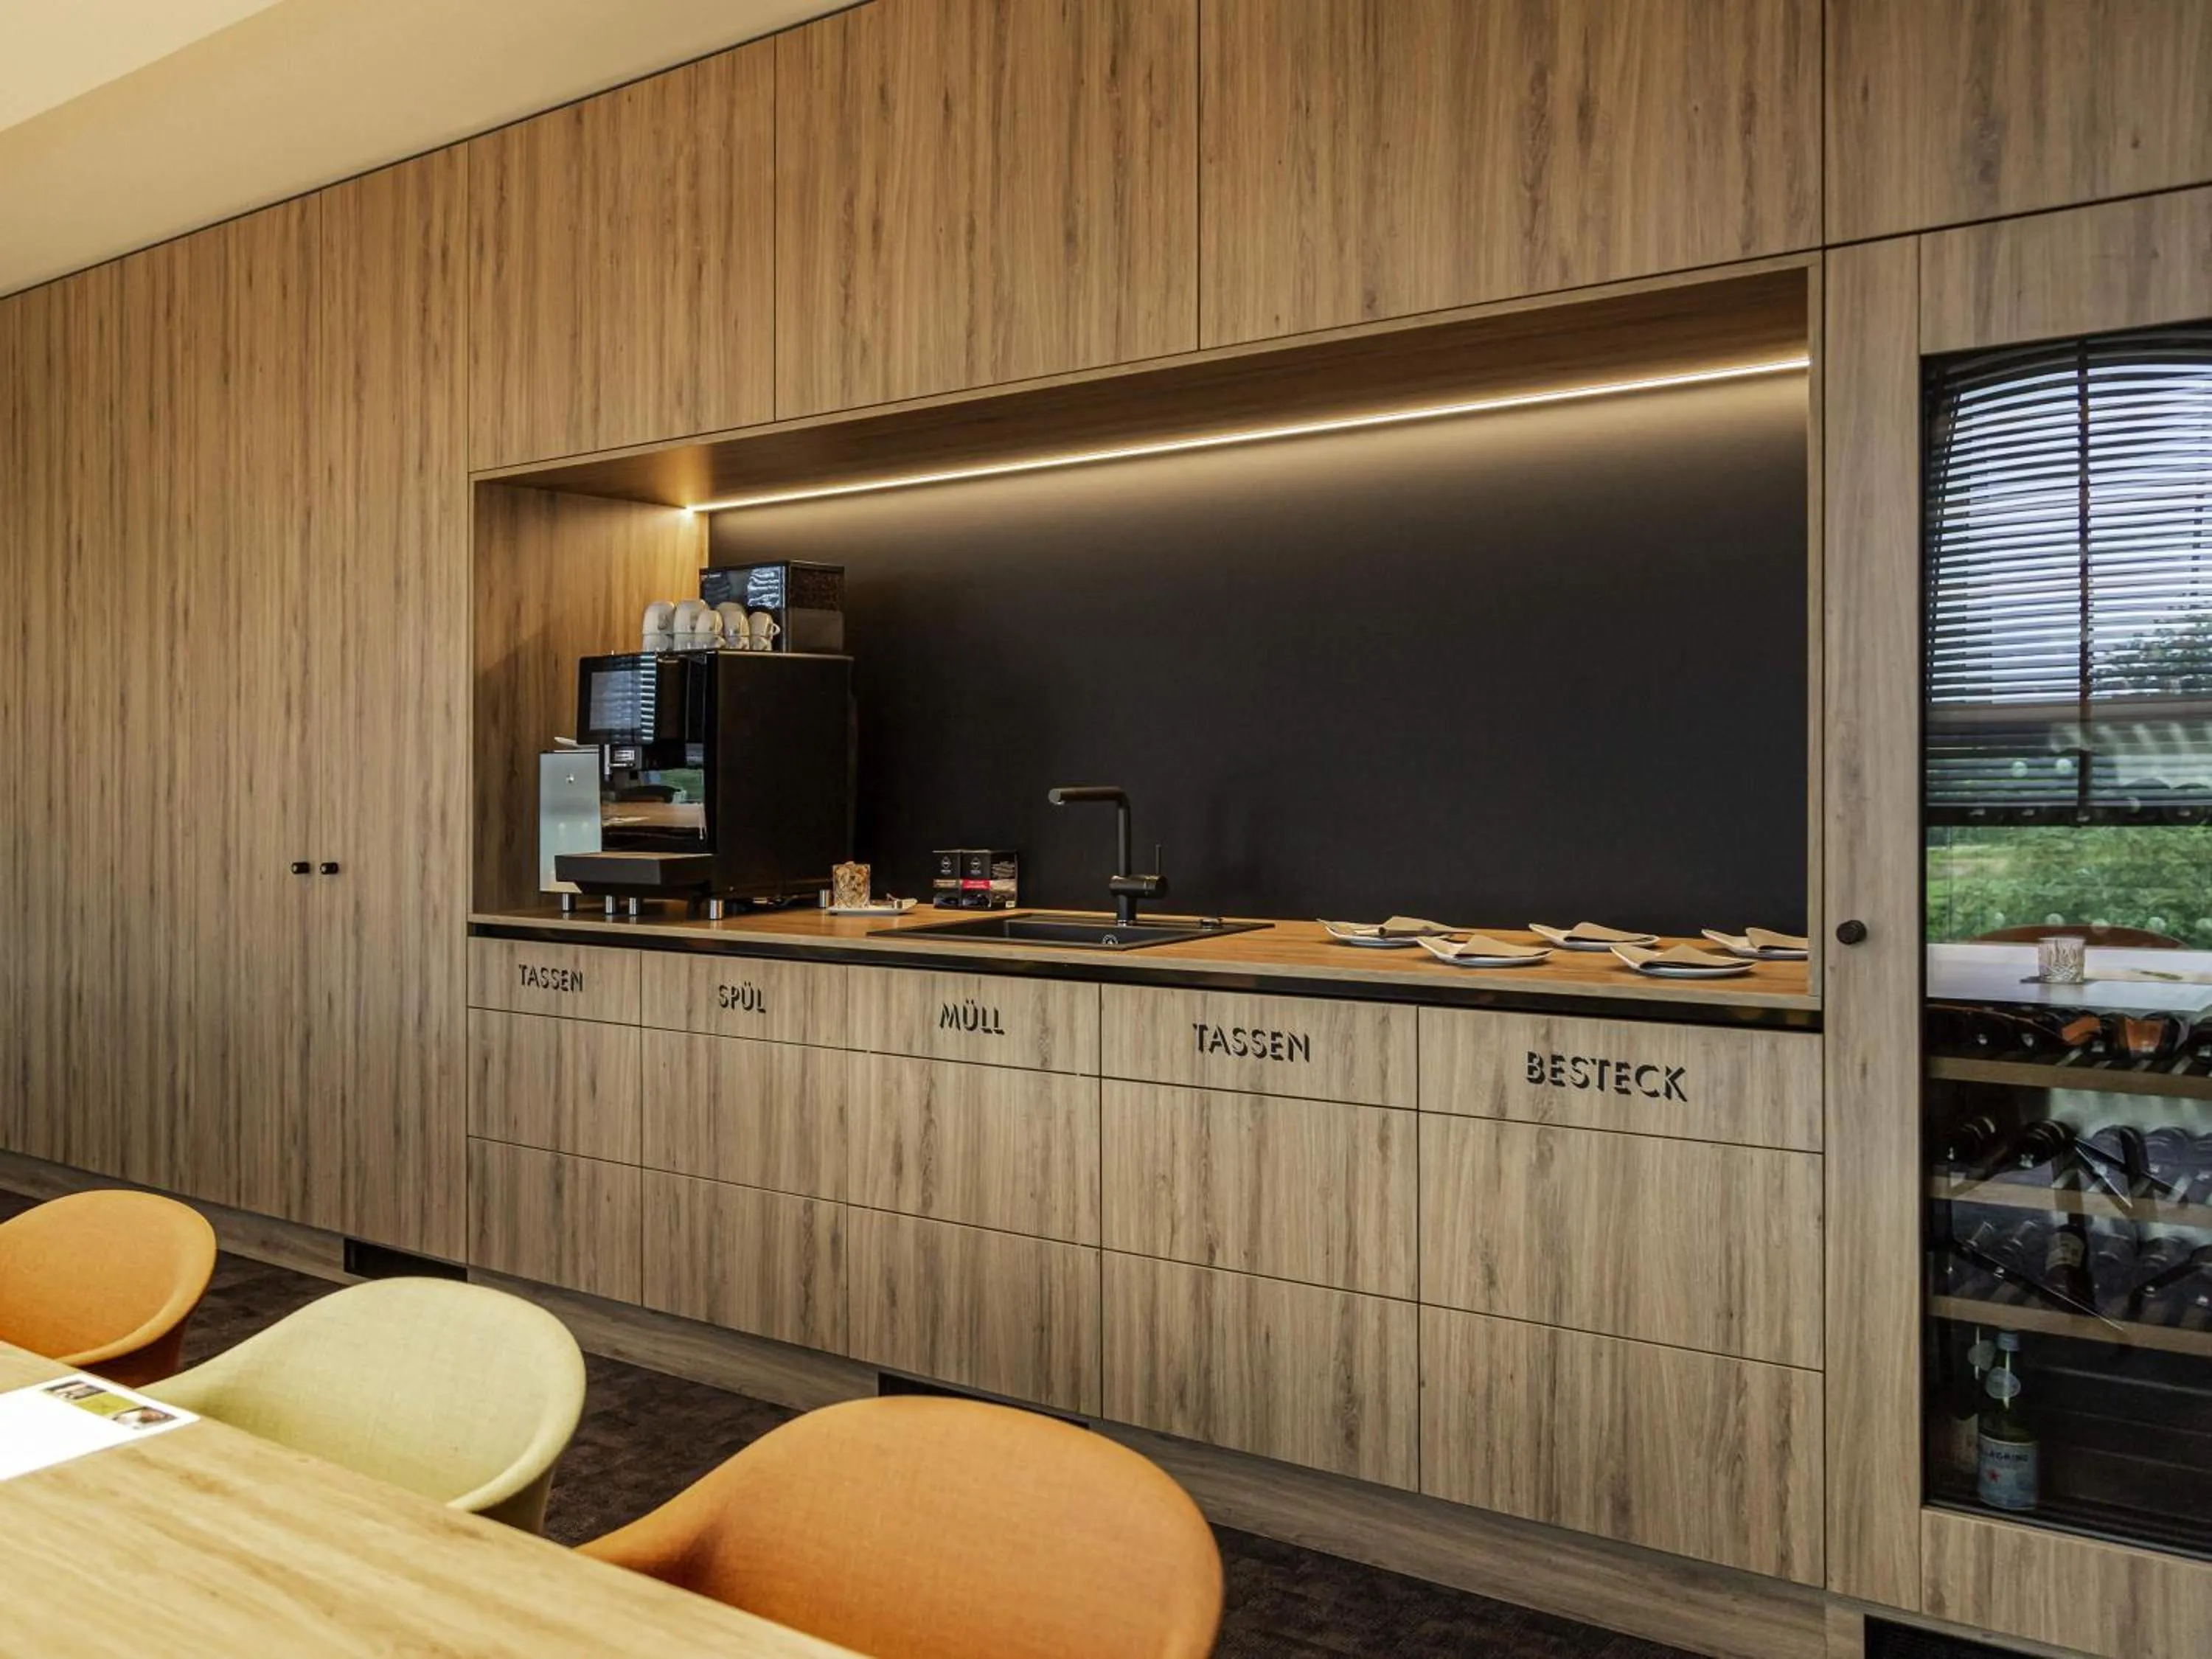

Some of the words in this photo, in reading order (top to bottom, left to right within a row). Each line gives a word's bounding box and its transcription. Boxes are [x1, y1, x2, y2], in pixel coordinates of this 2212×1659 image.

[518, 964, 583, 992] TASSEN
[719, 981, 766, 1014] SPÜL
[939, 998, 1004, 1035] MÜLL
[1192, 1023, 1310, 1063] TASSEN
[1526, 1051, 1688, 1102] BESTECK
